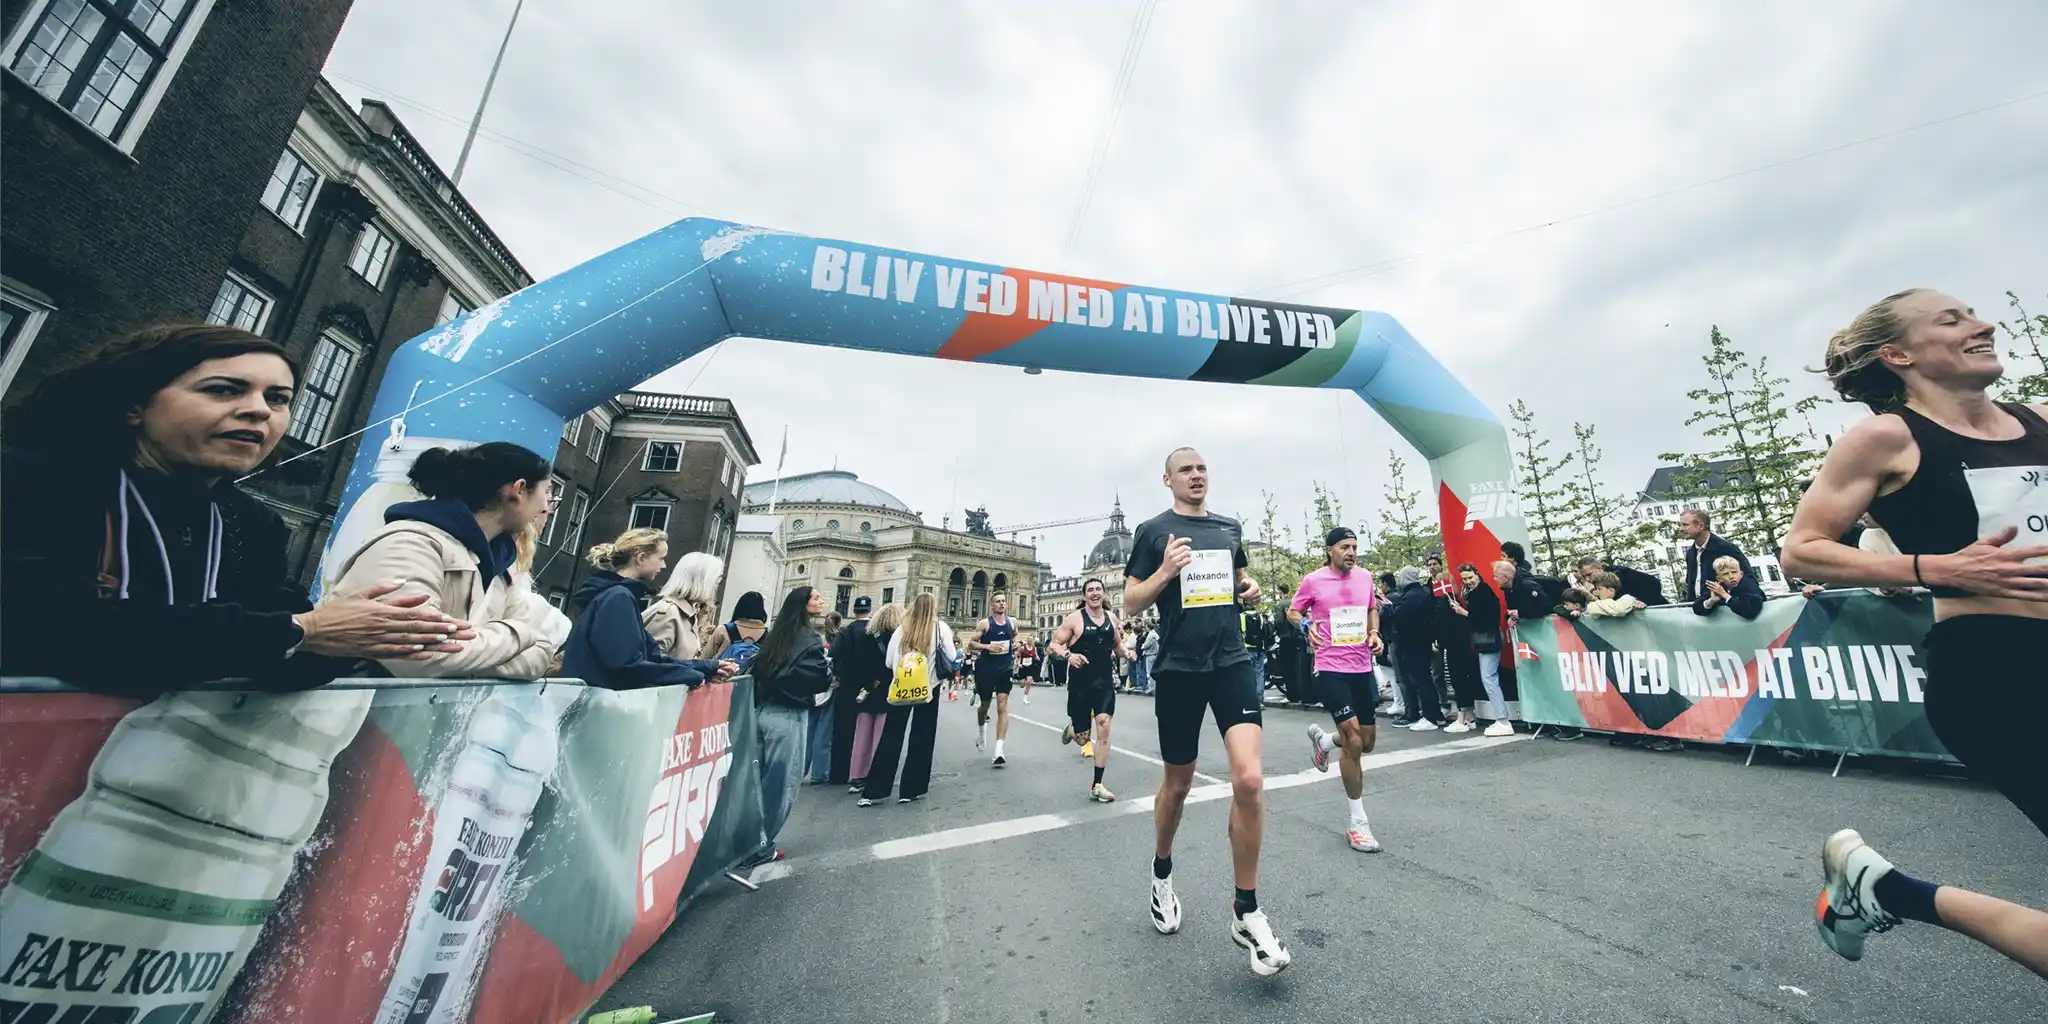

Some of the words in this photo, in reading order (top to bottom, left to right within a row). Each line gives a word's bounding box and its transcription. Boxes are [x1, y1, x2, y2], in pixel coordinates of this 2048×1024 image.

[810, 246, 924, 303] BLIV
[935, 265, 1018, 316] VED
[1028, 278, 1115, 328] MED
[1123, 292, 1170, 336] AT
[1177, 301, 1271, 345] BLIVE
[1279, 310, 1336, 349] VED
[1186, 572, 1229, 582] Alexander
[896, 685, 929, 699] 42.195
[1558, 650, 1608, 693] BLIV
[1611, 650, 1670, 695] VED
[1673, 649, 1749, 698] MED
[1755, 647, 1797, 699] AT
[1801, 644, 1926, 704] BLIVE
[473, 830, 514, 860] KONDI
[0, 932, 126, 993] FAXE
[112, 948, 235, 996] KONDI
